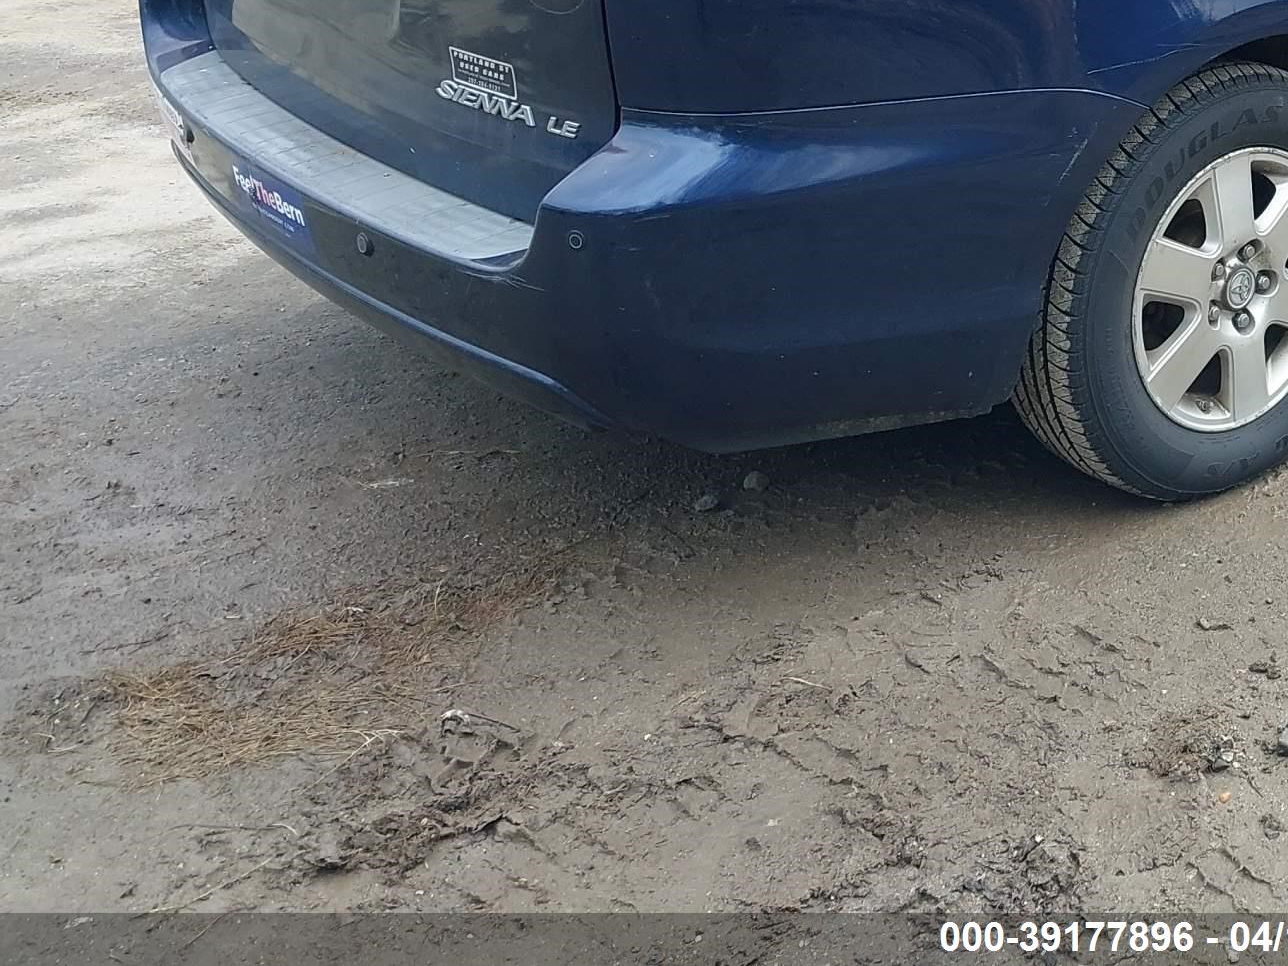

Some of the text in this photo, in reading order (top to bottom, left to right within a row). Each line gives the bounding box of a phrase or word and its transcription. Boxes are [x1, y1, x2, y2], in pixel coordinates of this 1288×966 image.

[453, 50, 496, 69] PORTLAND
[459, 61, 480, 73] USED
[482, 68, 505, 81] CARS
[435, 79, 582, 139] SIENNA LE
[1128, 105, 1283, 237] DOUGLAS
